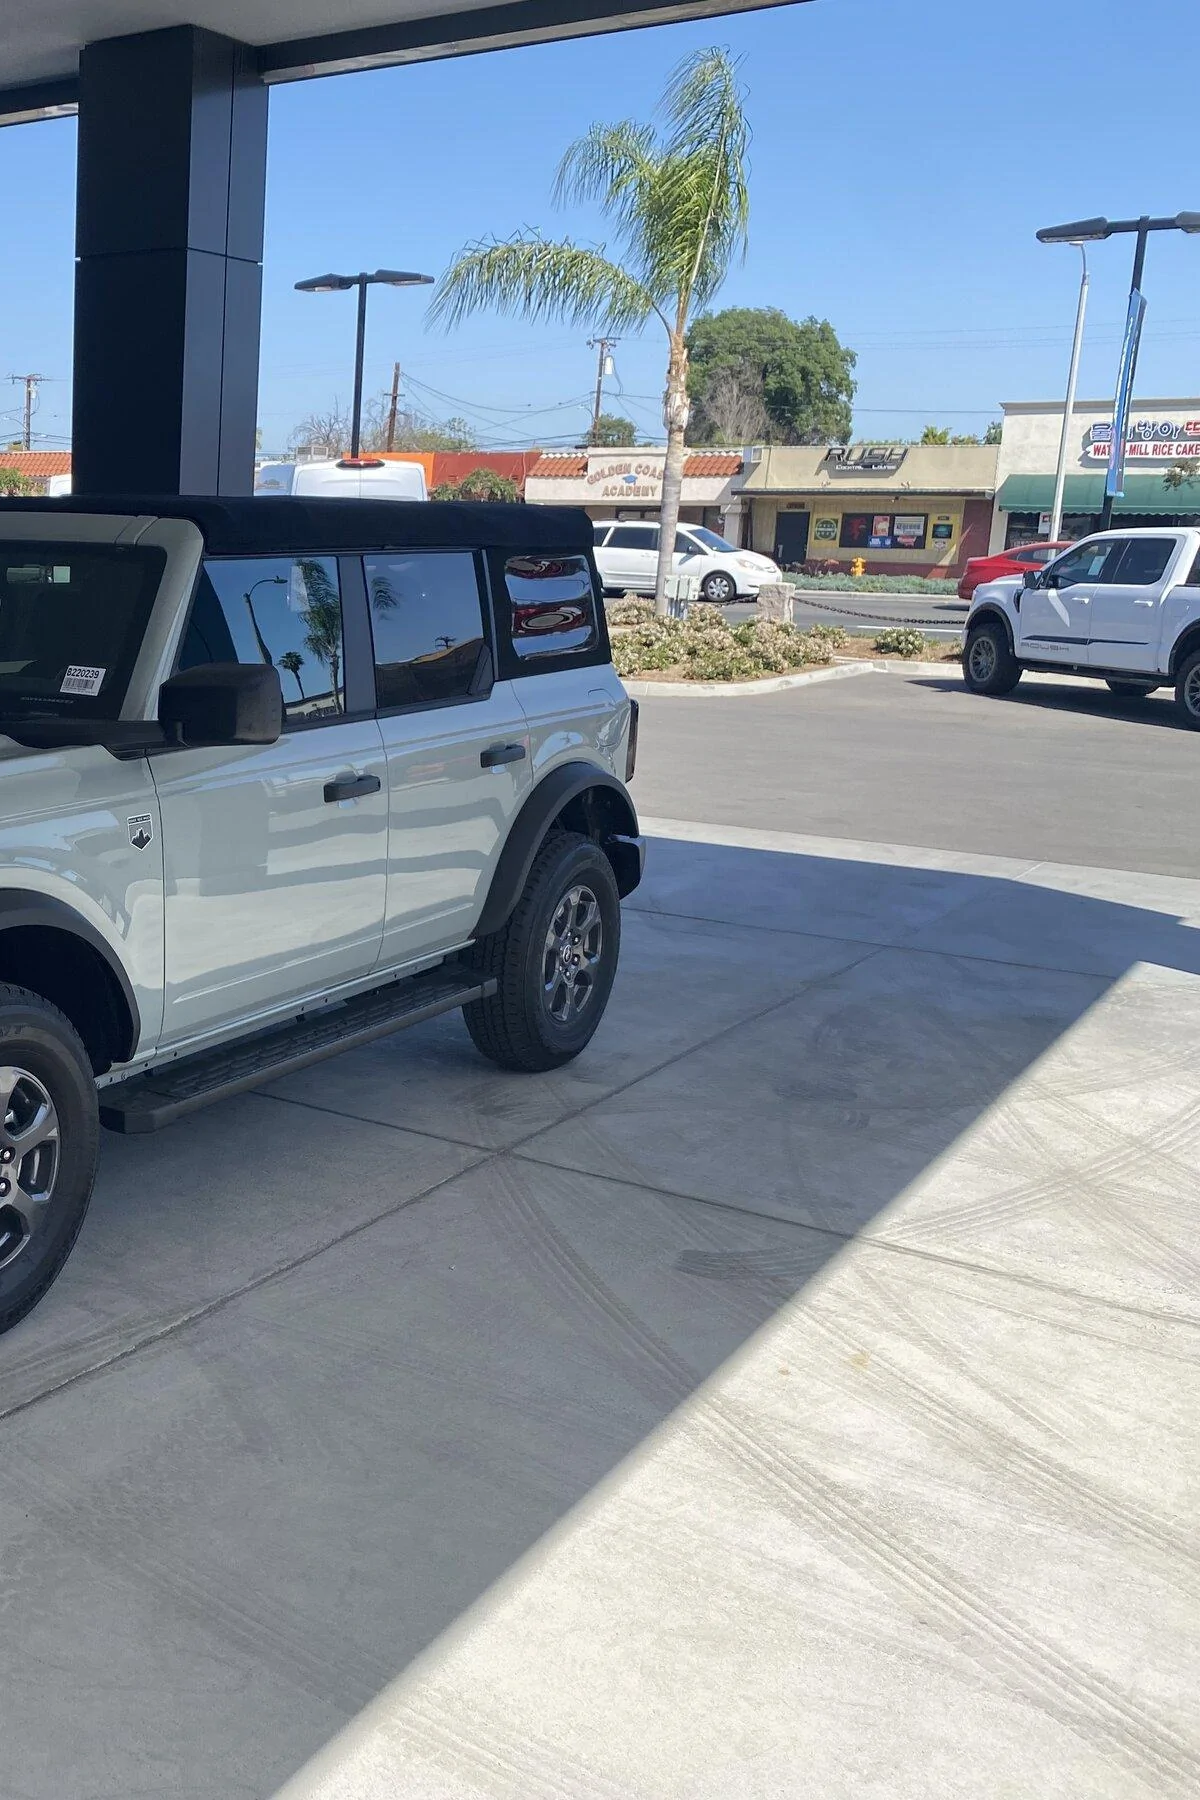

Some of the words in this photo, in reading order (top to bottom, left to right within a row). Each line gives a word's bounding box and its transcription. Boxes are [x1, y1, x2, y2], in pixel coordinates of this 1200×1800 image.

[1090, 420, 1181, 440] 물방아
[824, 447, 909, 463] RUSH
[1093, 443, 1150, 456] WAT-MILL
[1152, 443, 1174, 456] RICE
[1175, 443, 1200, 456] CAKE
[587, 463, 632, 484] GOLDEN
[634, 464, 663, 480] COAS
[601, 485, 658, 497] ACADEMY
[1020, 641, 1070, 651] ROUSH
